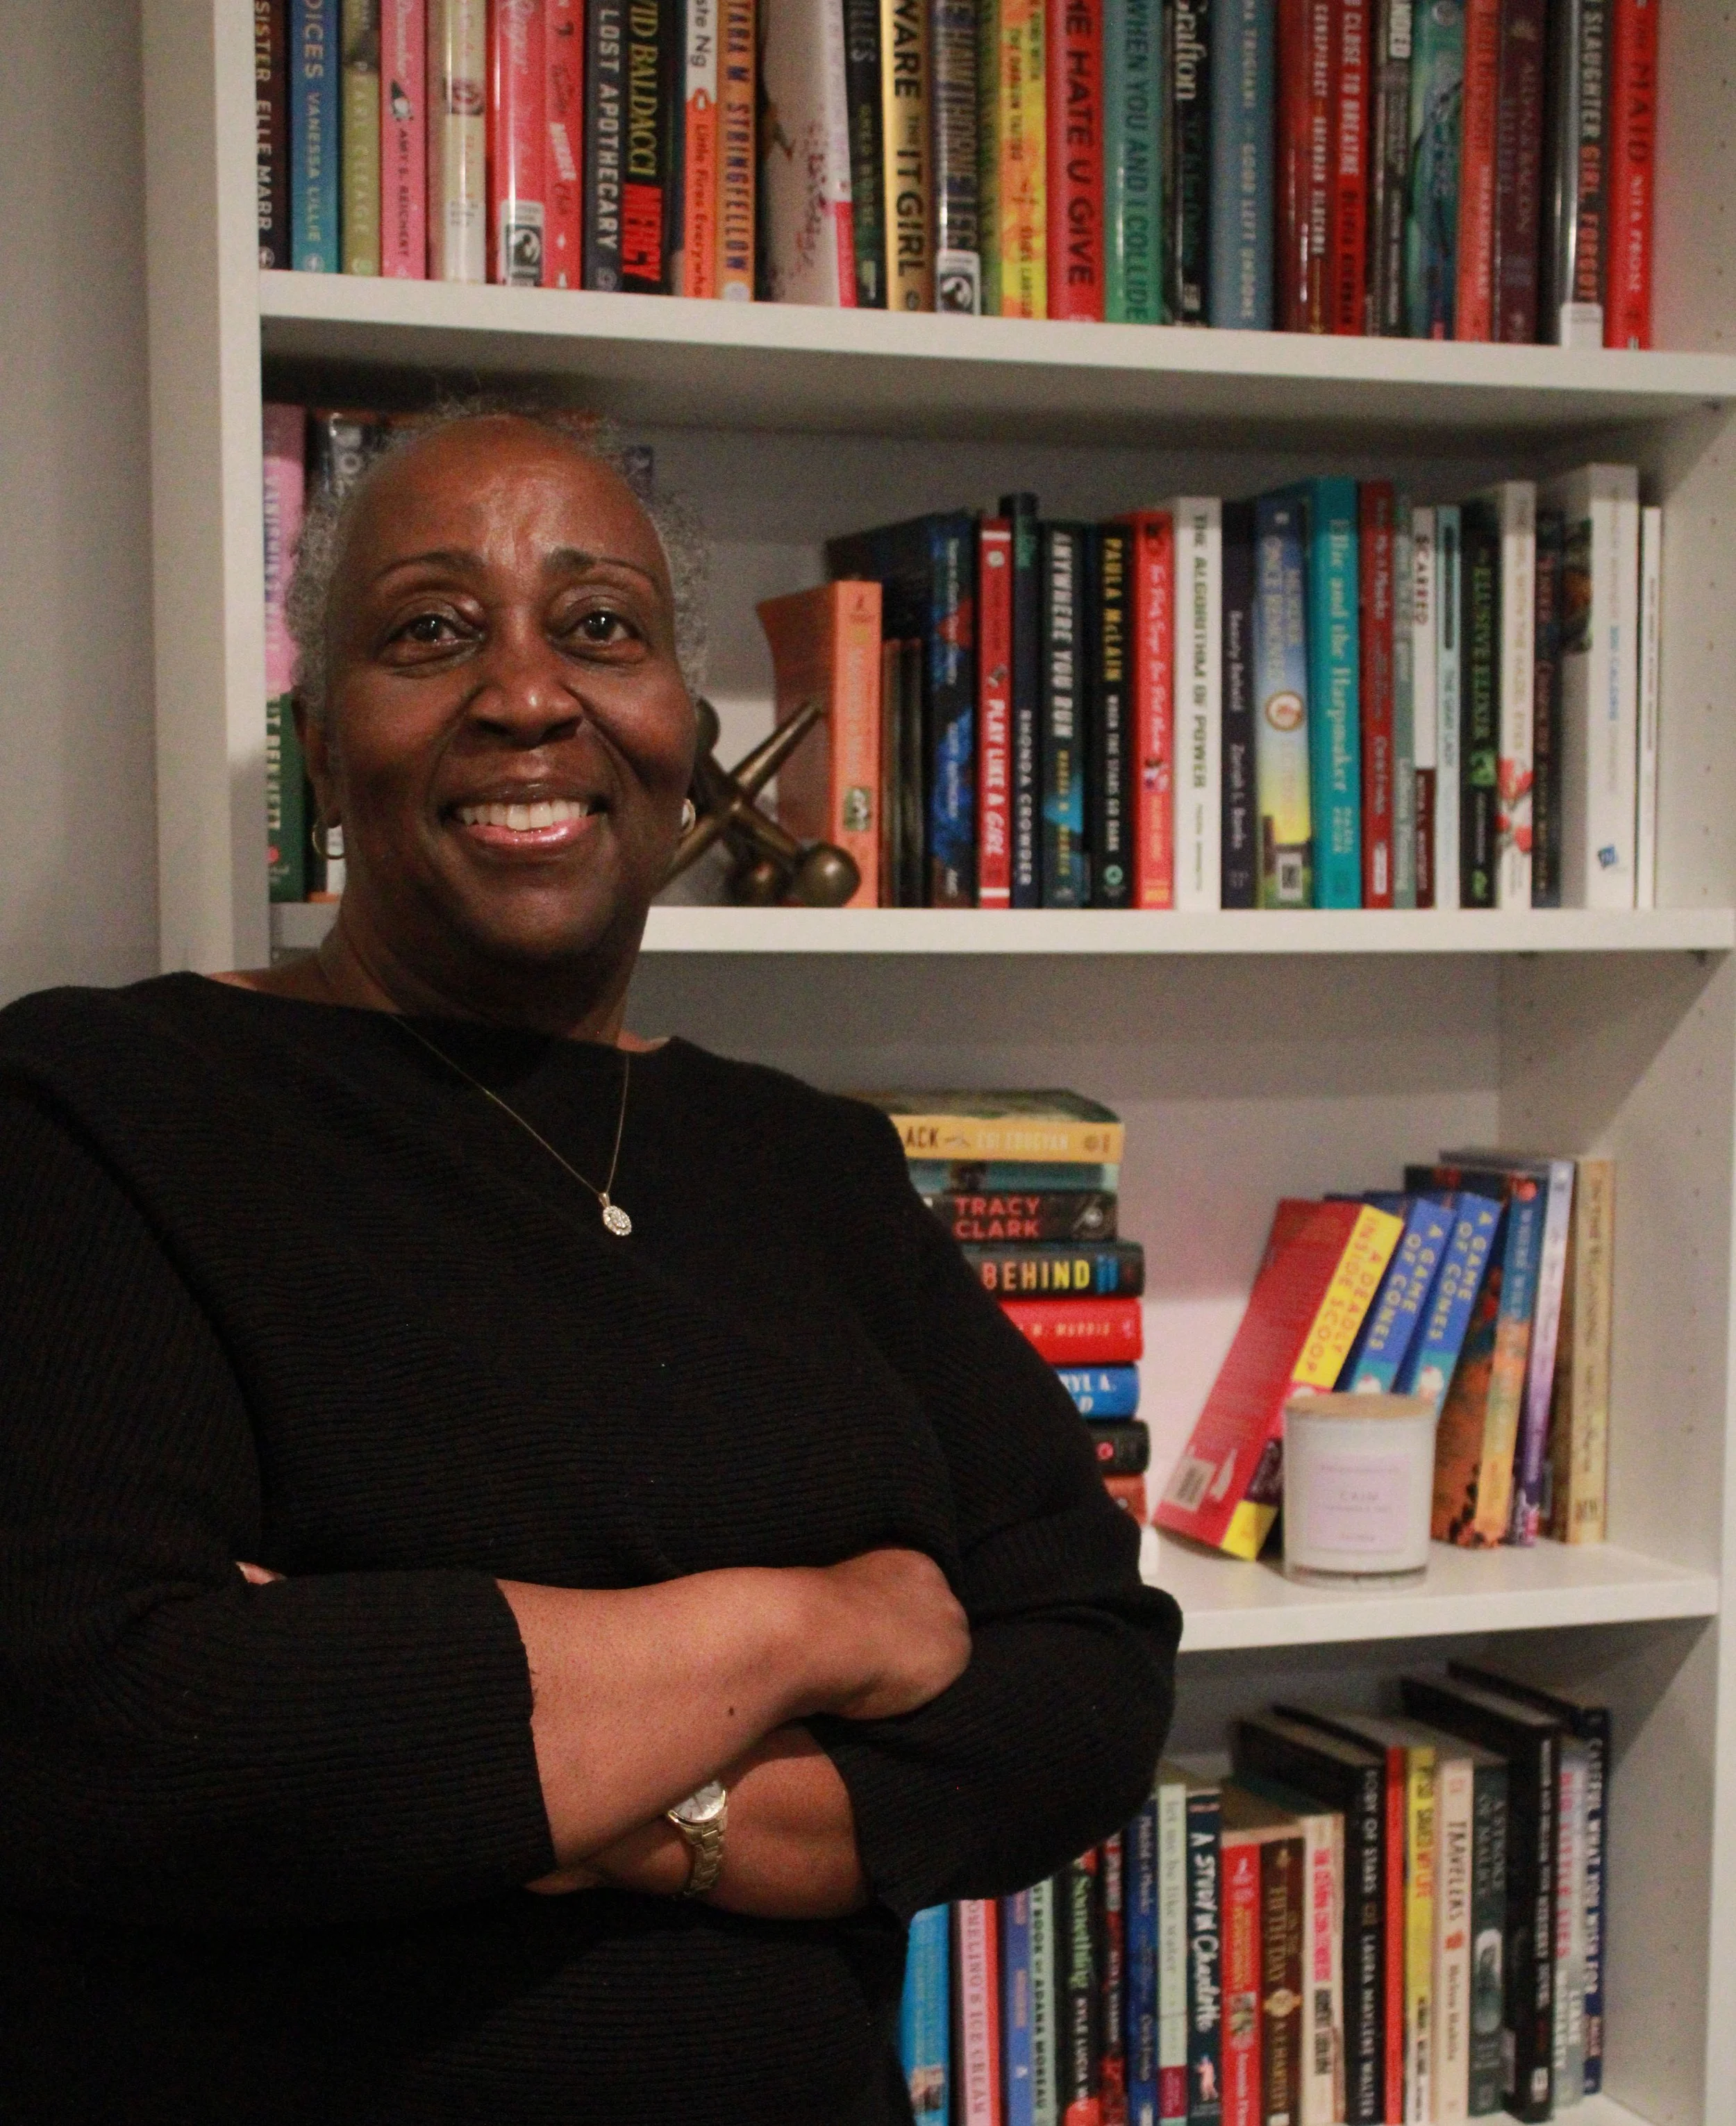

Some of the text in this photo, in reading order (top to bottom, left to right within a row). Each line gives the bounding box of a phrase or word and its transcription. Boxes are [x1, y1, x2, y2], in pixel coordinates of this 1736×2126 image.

[256, 1, 272, 83] SISTER
[303, 0, 324, 79] OICES
[692, 33, 711, 68] Ng
[1126, 0, 1150, 71] WHEN
[1583, 11, 1603, 139] SLAUGHTER
[628, 0, 658, 178] VID BALDACCI
[1126, 80, 1150, 131] YOU
[258, 99, 274, 230] ELLE MARR
[308, 92, 322, 242] VANESSA LILLIE
[597, 10, 620, 253] LOST APOTHECARY
[726, 1, 751, 272] TARA STRINGFELLOW
[897, 150, 923, 185] IT
[1067, 0, 1094, 287] HE HATE U GIVE
[1126, 139, 1150, 193] AND
[691, 124, 708, 298] Little Fires Everywhe
[896, 190, 926, 278] GIRL
[1126, 214, 1150, 322] COLLIDE
[1052, 532, 1074, 739] ANYWHERE YOU RUN
[1104, 538, 1122, 683] PAULA McLAIN
[1194, 557, 1208, 678] ALGORITHM
[1330, 576, 1351, 617] and
[1330, 624, 1351, 659] the
[1194, 714, 1208, 788] POWER
[1326, 667, 1352, 792] Harpmaker
[985, 699, 1005, 856] PLAY LIKE A GIRL
[1019, 709, 1033, 886] RHONDA CROWDER
[952, 1218, 1041, 1240] CLARK
[953, 1196, 1042, 1217] TRACY
[980, 1258, 1091, 1292] BEHIND
[1368, 1232, 1422, 1351] OF CONES
[1400, 1247, 1436, 1313] GAME
[1428, 1221, 1474, 1341] OF CONES
[1457, 1236, 1487, 1301] GAME
[1191, 1832, 1216, 1848] A
[1362, 1846, 1378, 1894] STARS
[1363, 1818, 1378, 1841] OF
[1447, 1820, 1467, 1921] TRAVELERS
[1194, 1854, 1217, 1911] STUDY
[1033, 1908, 1046, 1954] BOOK
[1361, 1934, 1377, 1984] LAURA
[1192, 1934, 1220, 2034] Charlotte
[970, 2010, 987, 2114] ICE CREAM
[1360, 2060, 1376, 2117] WALTER
